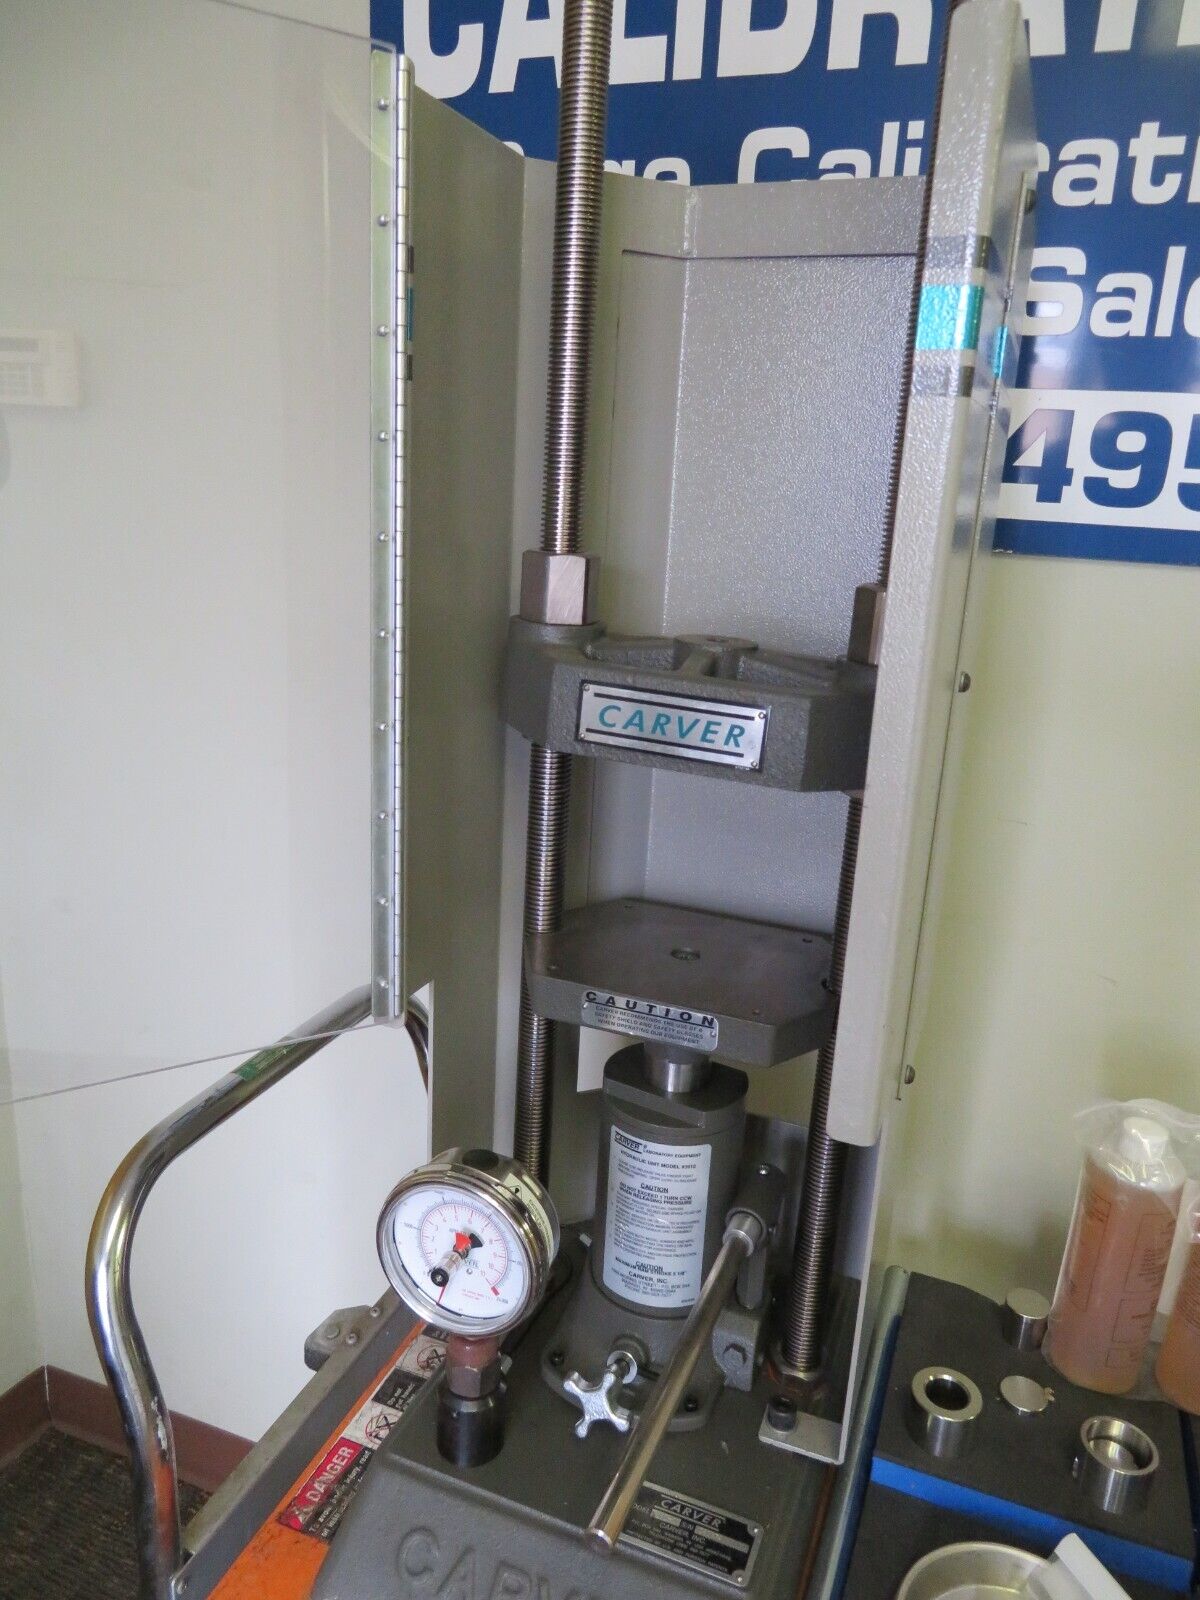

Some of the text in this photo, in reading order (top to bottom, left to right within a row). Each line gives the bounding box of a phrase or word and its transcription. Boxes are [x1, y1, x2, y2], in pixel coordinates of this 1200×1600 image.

[598, 705, 746, 748] CARVER
[585, 991, 715, 1027] CAUTION
[640, 1182, 669, 1193] CAUTION
[636, 1260, 663, 1271] CAUTION
[306, 1446, 354, 1501] DANGER
[661, 1499, 722, 1529] CARVER
